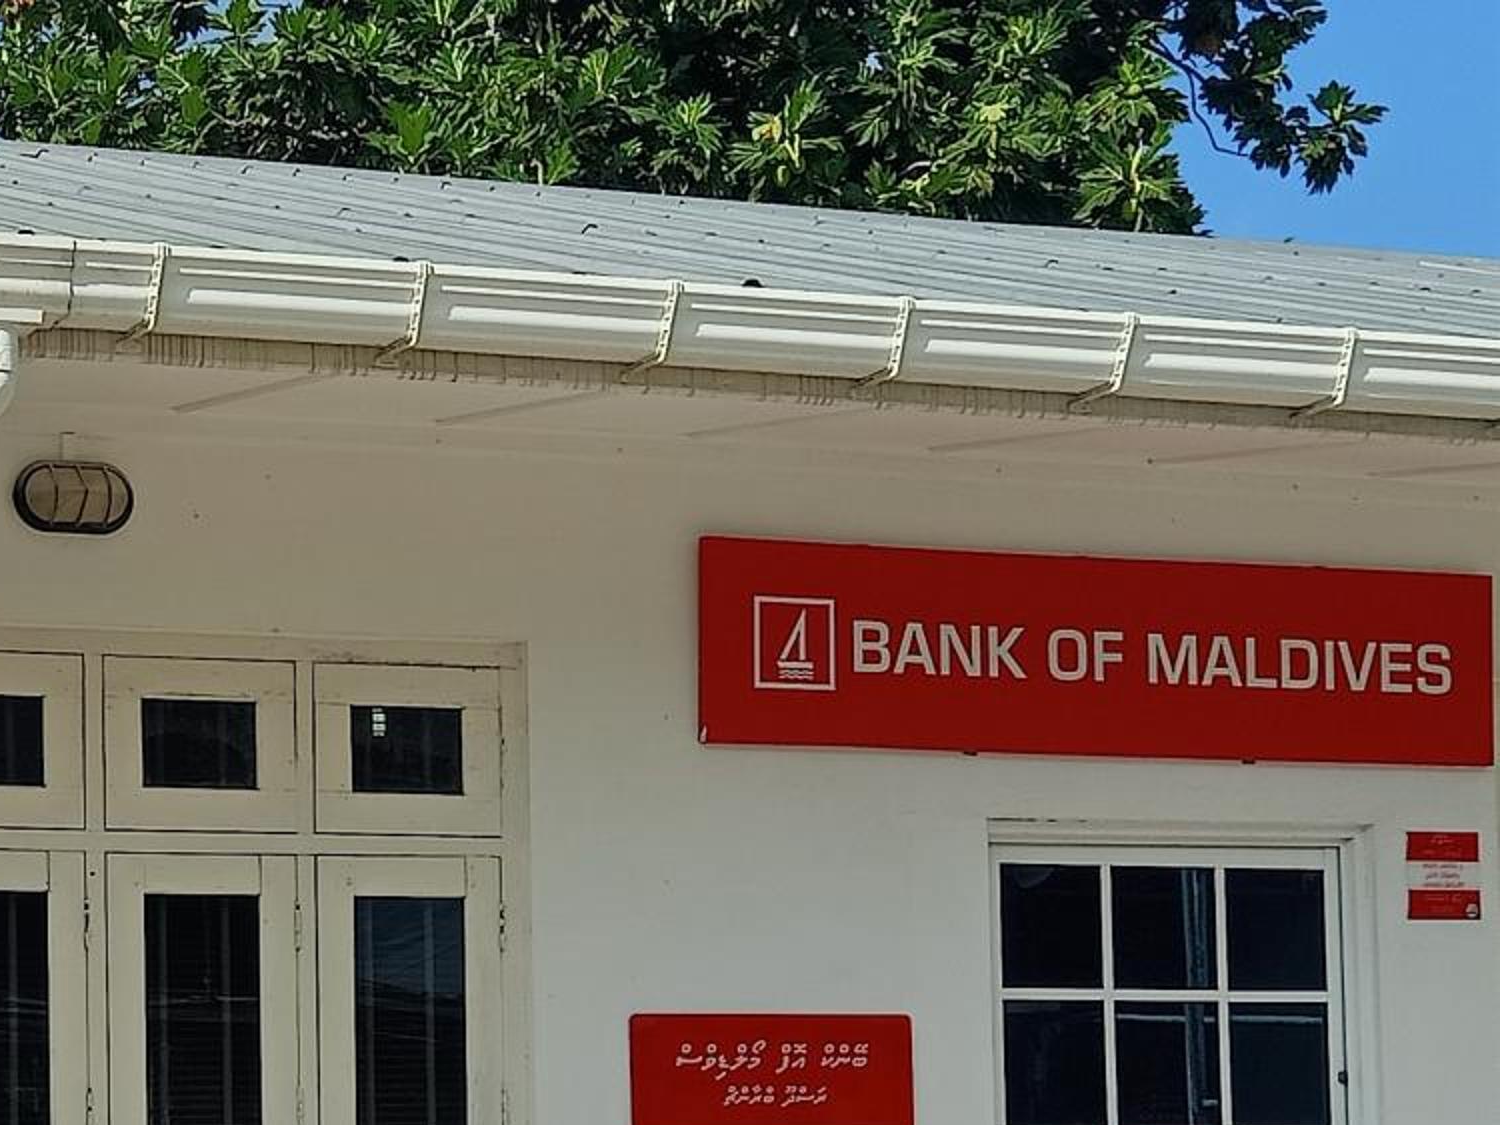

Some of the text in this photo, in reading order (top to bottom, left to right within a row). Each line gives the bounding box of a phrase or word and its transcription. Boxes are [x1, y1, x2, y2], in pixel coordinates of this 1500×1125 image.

[852, 619, 1453, 696] BANK OF MALDIVES
[775, 1043, 808, 1074] އޮފް
